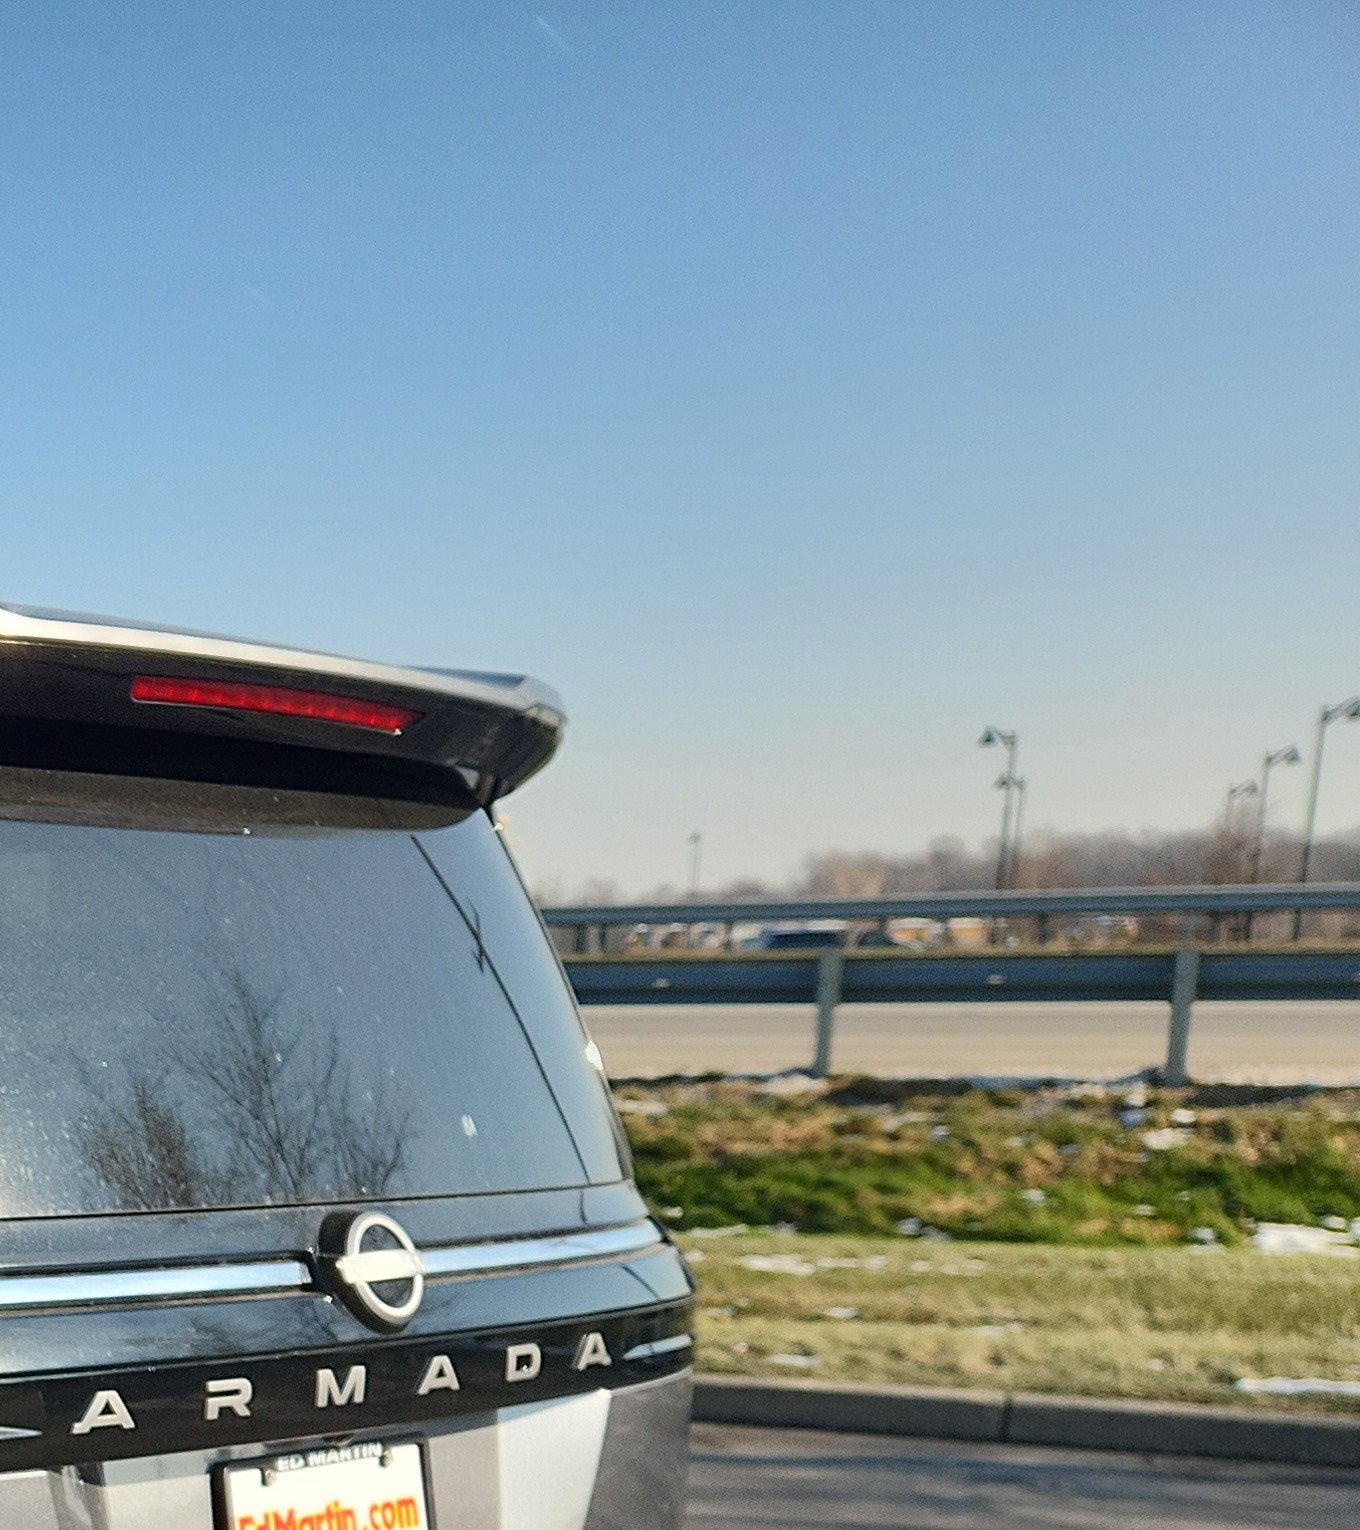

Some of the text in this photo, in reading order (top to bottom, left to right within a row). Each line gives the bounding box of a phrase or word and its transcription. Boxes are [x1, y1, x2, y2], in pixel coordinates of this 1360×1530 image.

[70, 1331, 613, 1435] ARMADA
[277, 1442, 385, 1472] ED MARTIN
